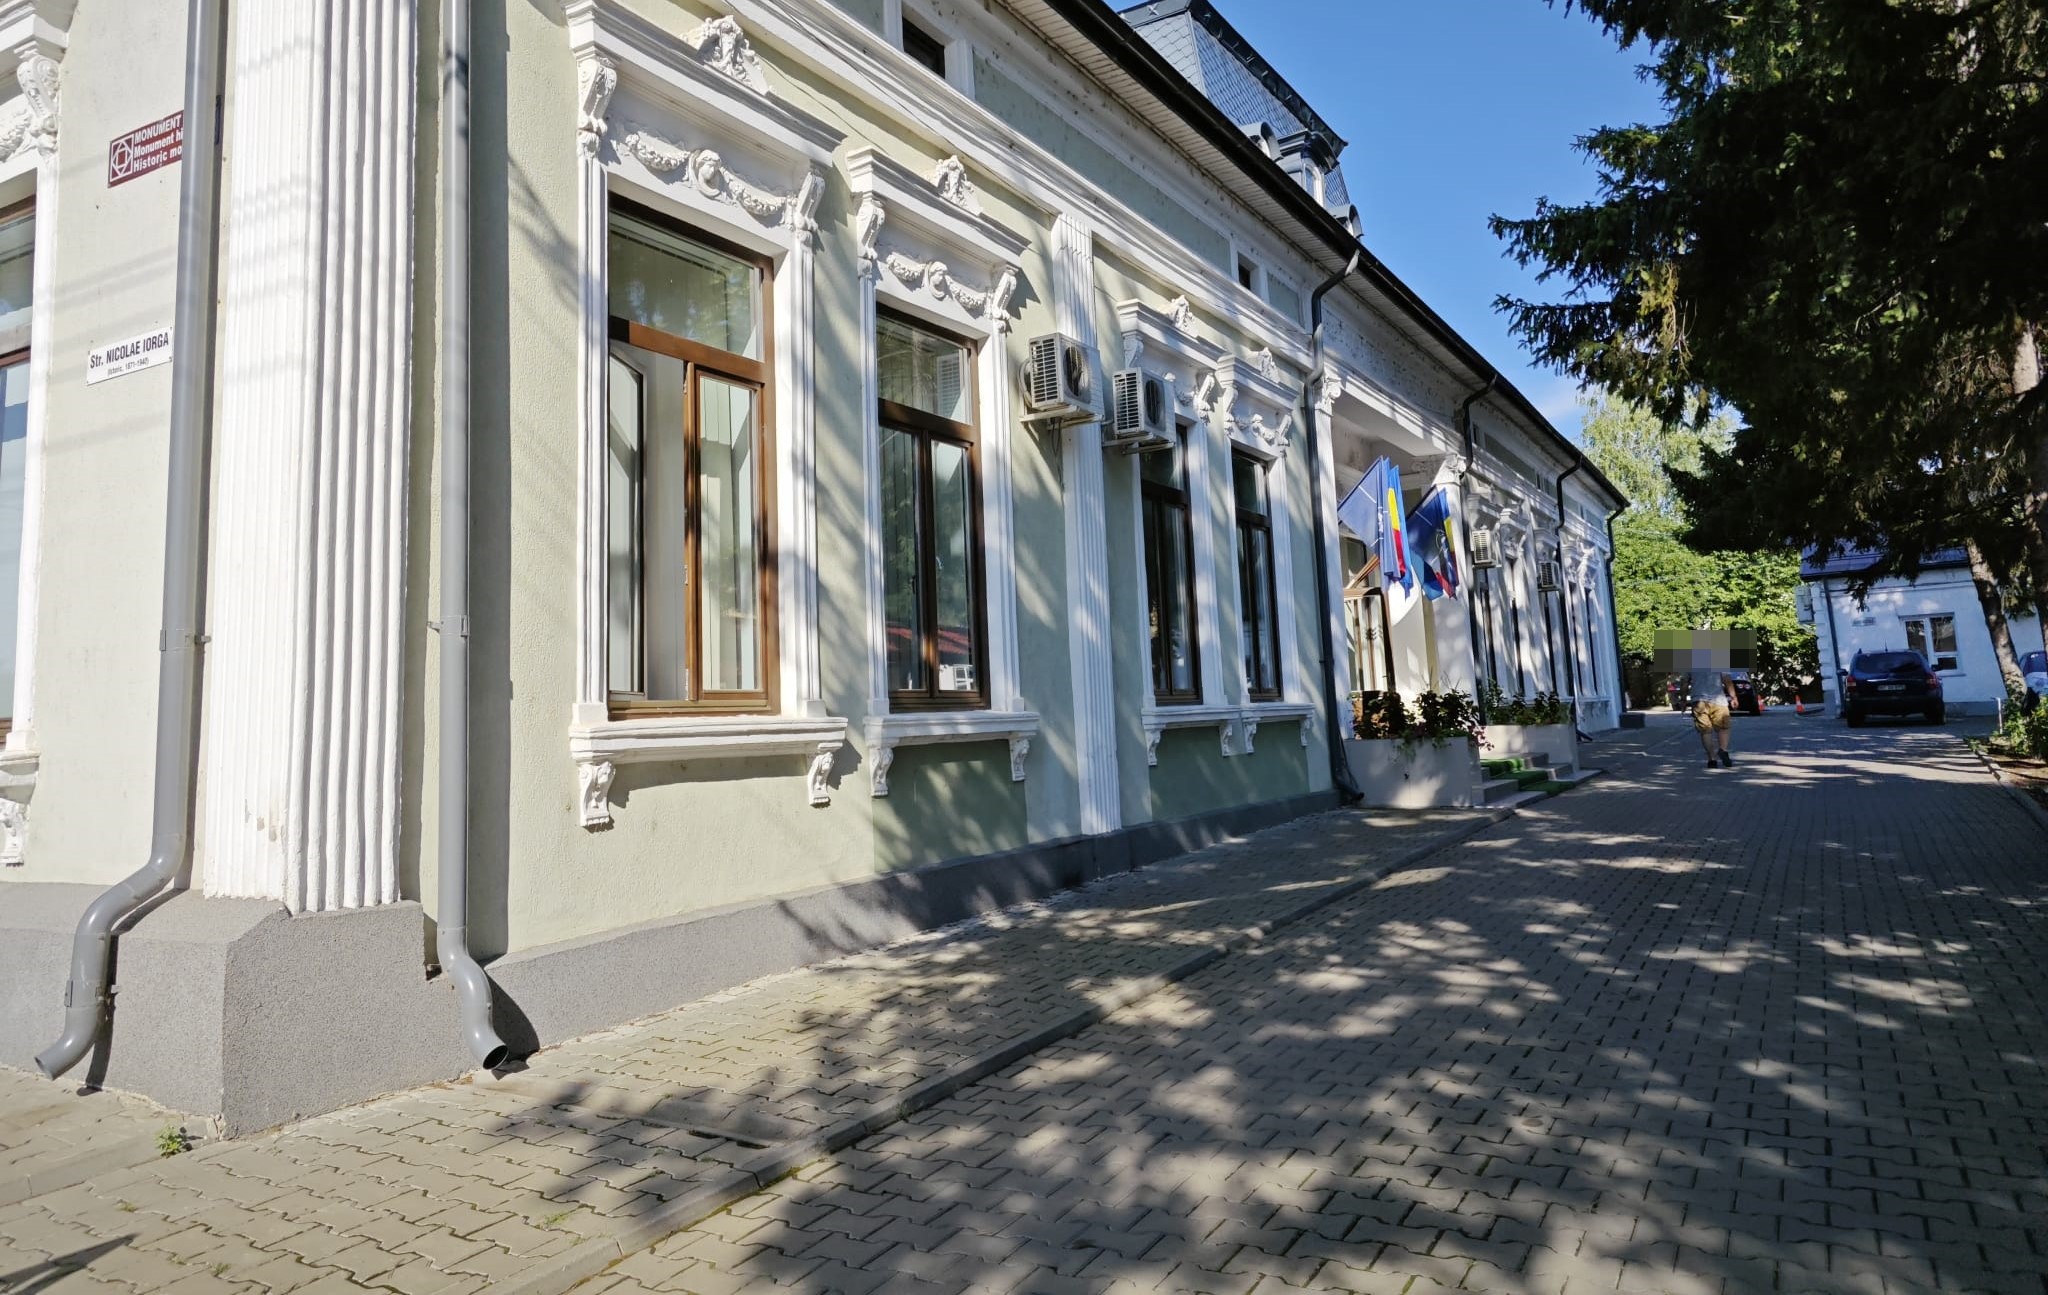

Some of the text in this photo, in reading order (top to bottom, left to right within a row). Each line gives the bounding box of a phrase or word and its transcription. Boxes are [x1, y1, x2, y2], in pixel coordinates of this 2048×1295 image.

[134, 114, 181, 145] MONUMENT
[134, 132, 174, 158] Monument
[134, 151, 168, 172] Historic
[90, 332, 169, 369] Str. NICOLAE IORGA
